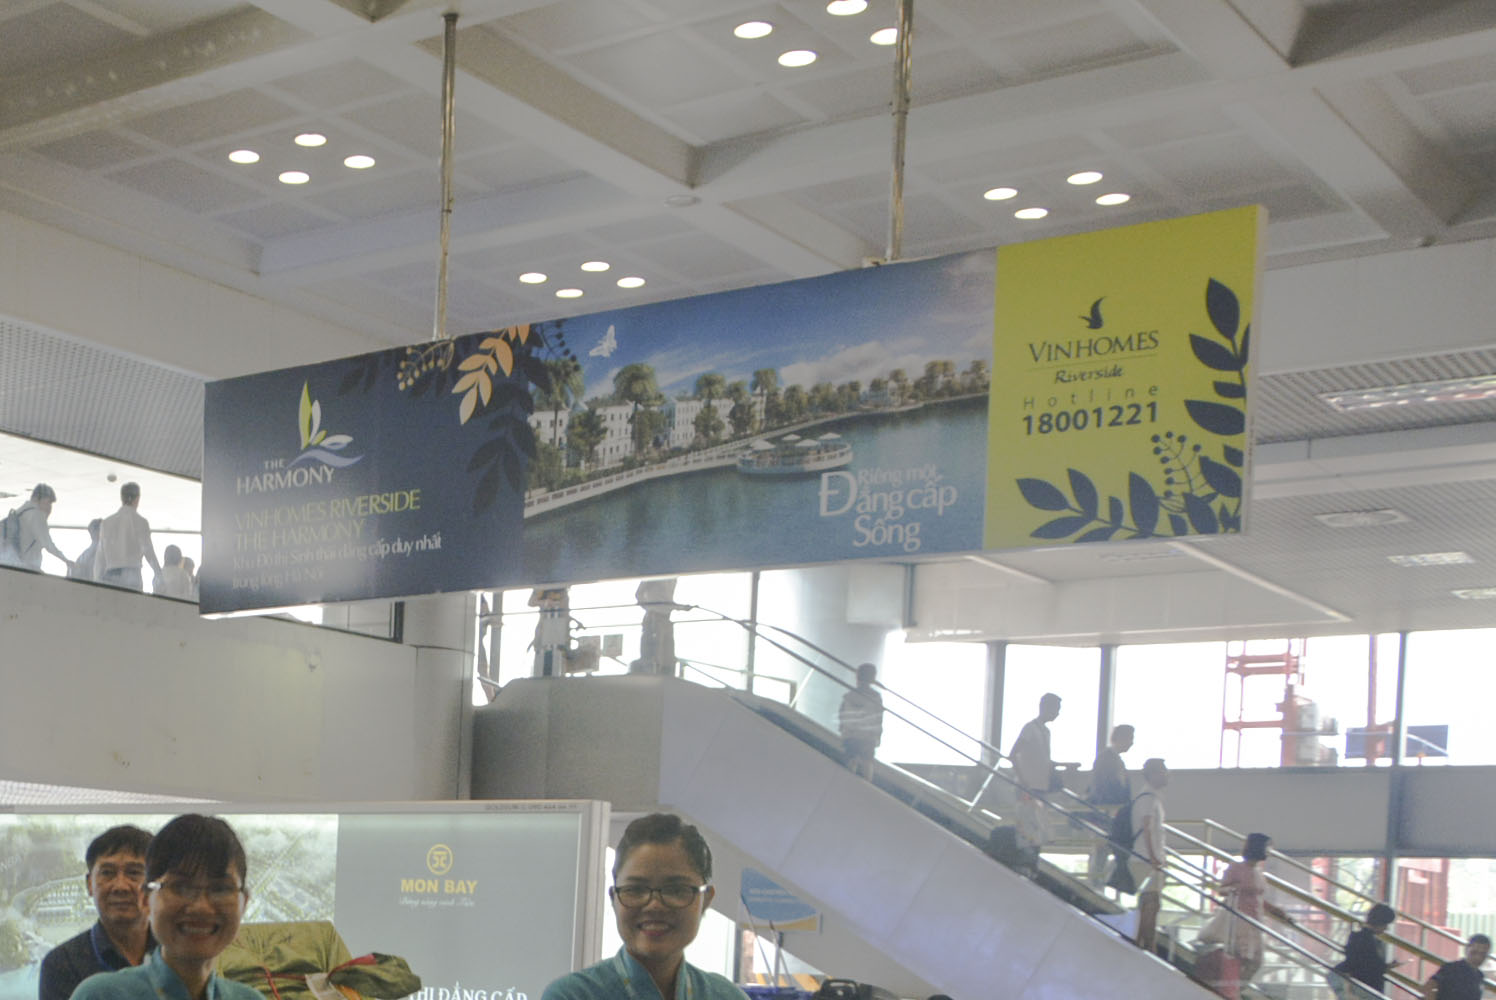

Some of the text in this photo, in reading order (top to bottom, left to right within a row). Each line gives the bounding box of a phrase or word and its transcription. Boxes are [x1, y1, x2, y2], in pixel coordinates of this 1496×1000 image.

[1029, 330, 1159, 363] VINHOMES
[1055, 364, 1123, 384] Riverside
[1023, 385, 1158, 409] Hotline
[1022, 401, 1158, 435] 18001221
[264, 458, 285, 470] THE
[236, 464, 335, 496] HARMONY
[907, 473, 958, 516] cấp
[234, 488, 421, 530] VINHOMES RIVERSIDE
[236, 519, 366, 549] THE HARMONY
[391, 537, 413, 556] duy
[415, 531, 442, 551] nhất
[400, 879, 478, 894] MON BAY
